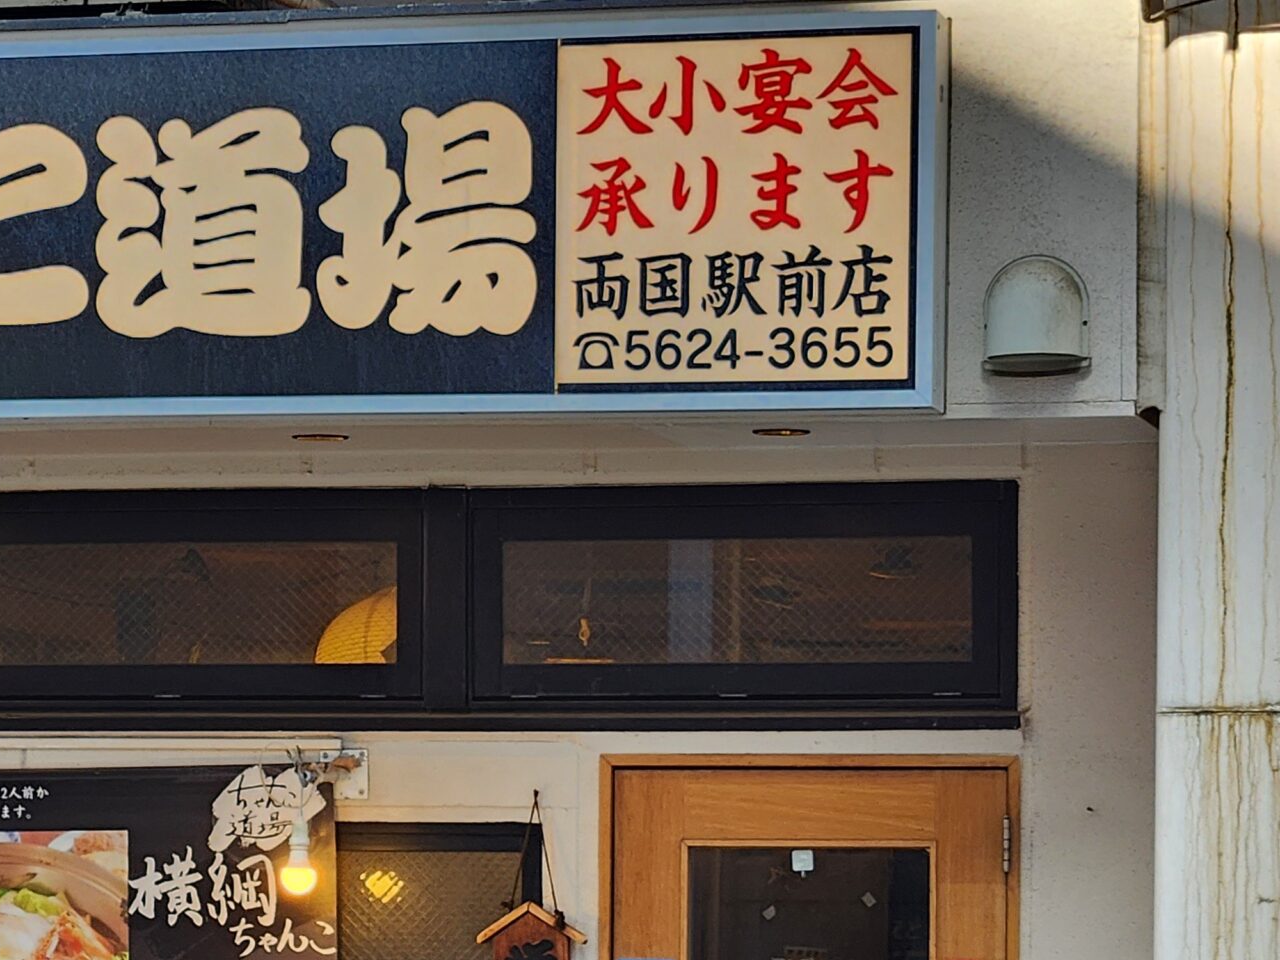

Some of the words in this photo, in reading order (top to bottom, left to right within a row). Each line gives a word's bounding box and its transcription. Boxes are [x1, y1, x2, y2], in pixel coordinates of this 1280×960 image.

[577, 48, 899, 137] 大小宴会
[573, 149, 896, 237] 承ります
[573, 244, 895, 322] 両国駅前店
[128, 848, 277, 927] 横綱
[229, 918, 338, 958] ちゃんこ
